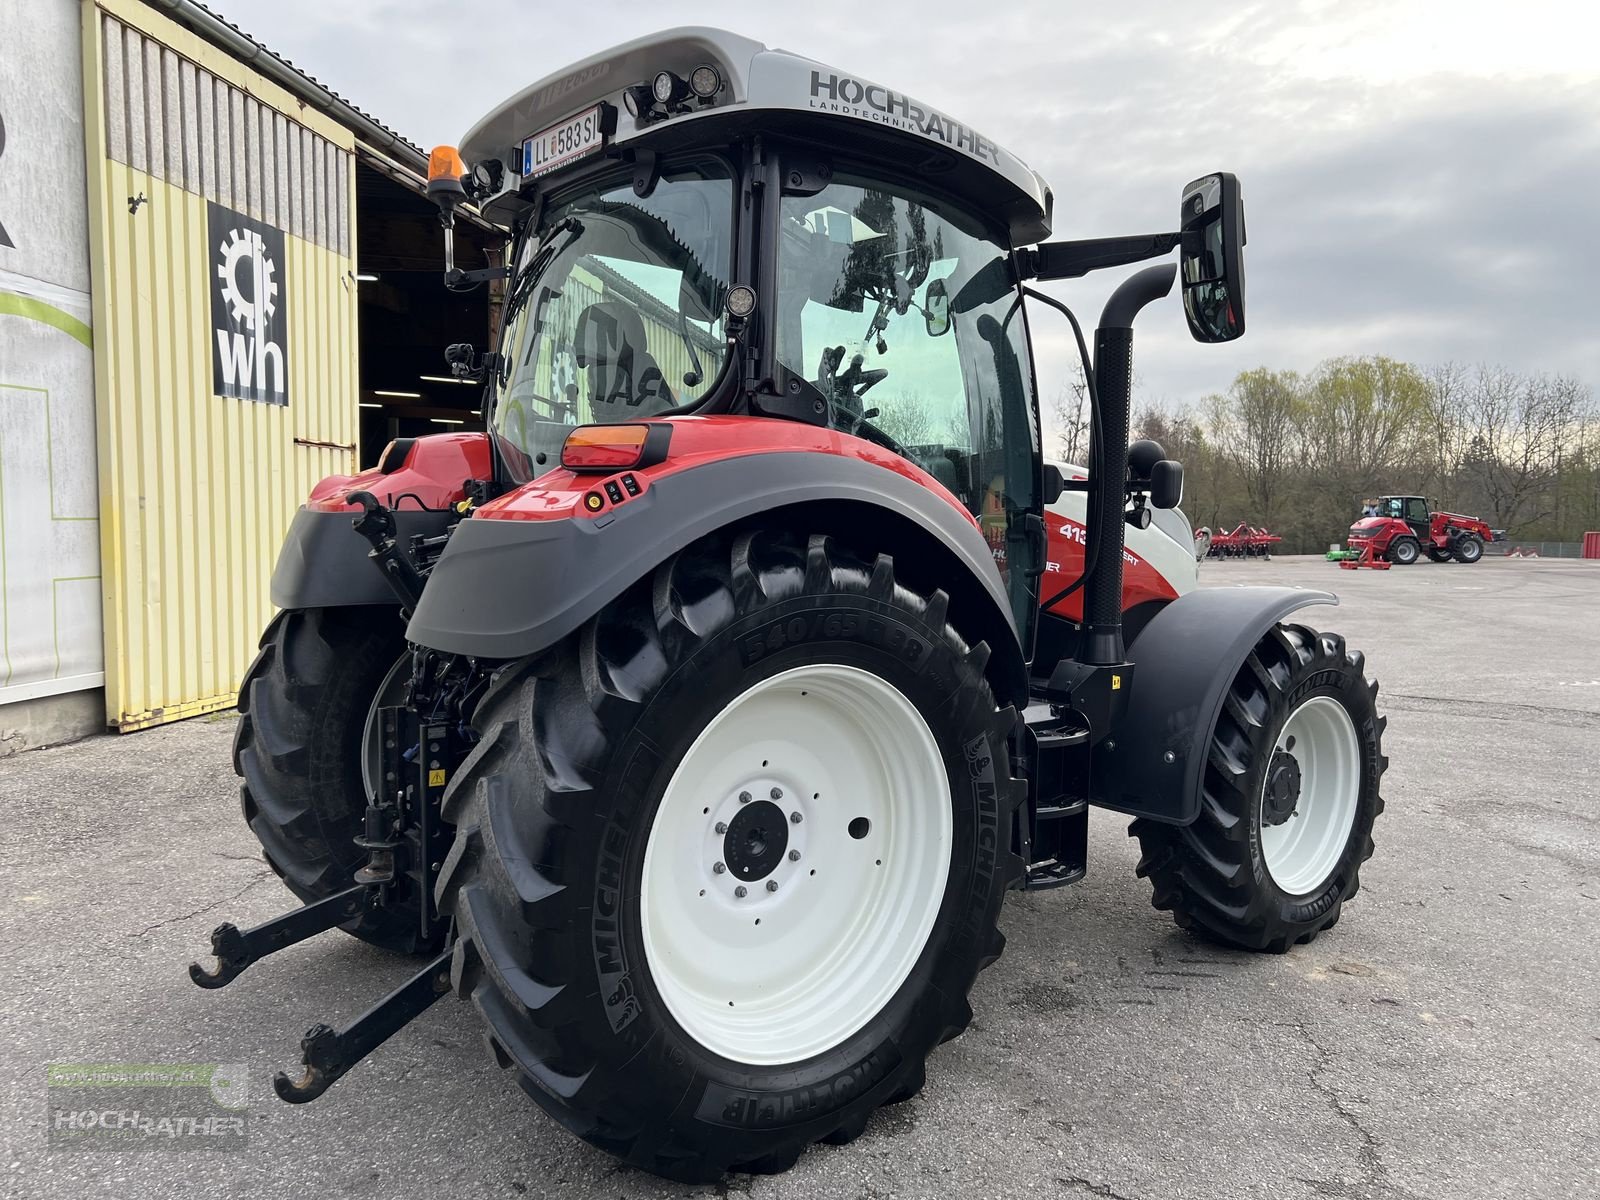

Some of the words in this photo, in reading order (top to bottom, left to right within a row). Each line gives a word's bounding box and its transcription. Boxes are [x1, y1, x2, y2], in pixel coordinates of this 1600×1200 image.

[809, 99, 915, 131] LANDTECHNIK
[810, 70, 1000, 166] HOCHRATHER
[535, 138, 549, 166] LL
[557, 123, 581, 154] 583
[1060, 524, 1087, 546] 413
[1122, 551, 1139, 566] ERT
